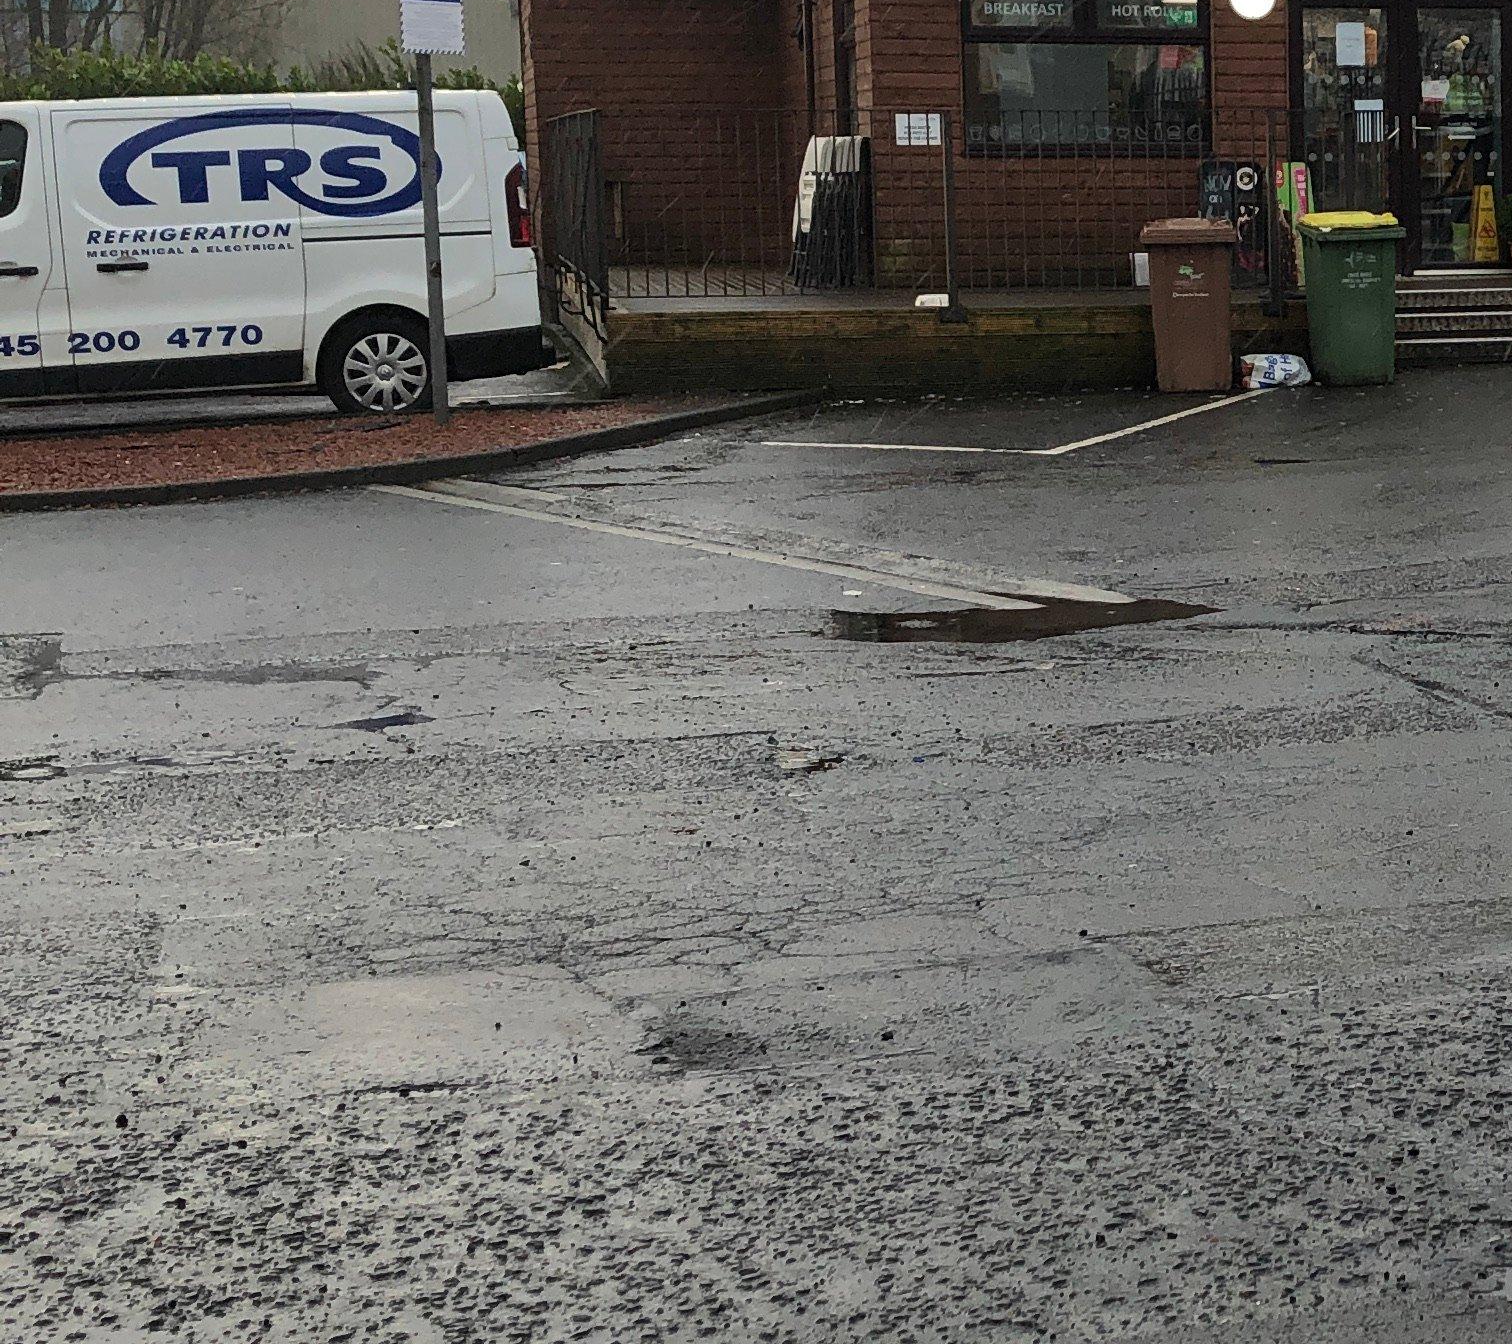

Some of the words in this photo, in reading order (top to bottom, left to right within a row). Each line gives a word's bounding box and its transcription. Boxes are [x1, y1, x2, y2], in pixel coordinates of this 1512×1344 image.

[984, 2, 1064, 16] BREAKFAST
[1111, 4, 1140, 17] HOT
[151, 144, 388, 203] TRS
[86, 222, 291, 245] REFRIGERATION
[86, 247, 184, 259] MECHANICAL
[206, 242, 295, 254] ELECTRICAL
[67, 330, 141, 354] 200
[166, 324, 263, 348] 4770
